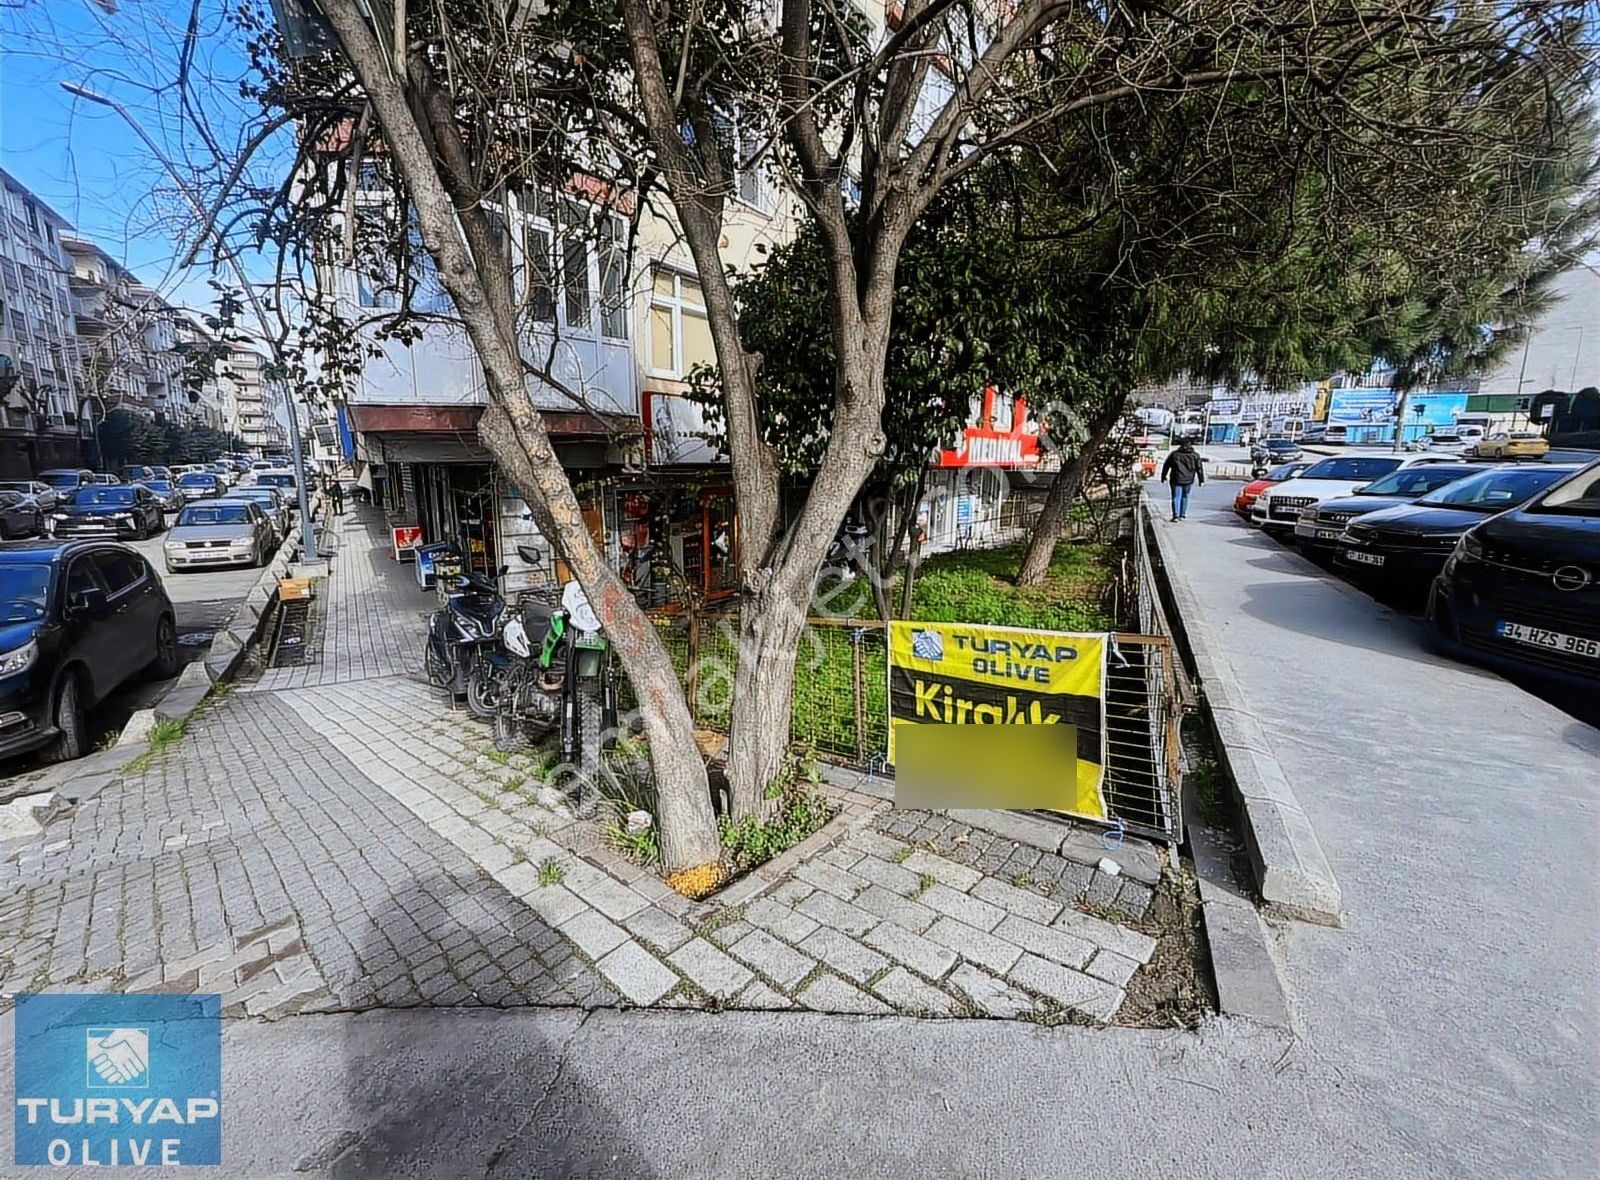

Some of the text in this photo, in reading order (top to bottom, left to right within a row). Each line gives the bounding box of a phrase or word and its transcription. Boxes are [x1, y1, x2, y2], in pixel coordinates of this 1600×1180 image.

[952, 634, 1078, 663] TURYAP
[1504, 623, 1598, 656] 34 HZS 966
